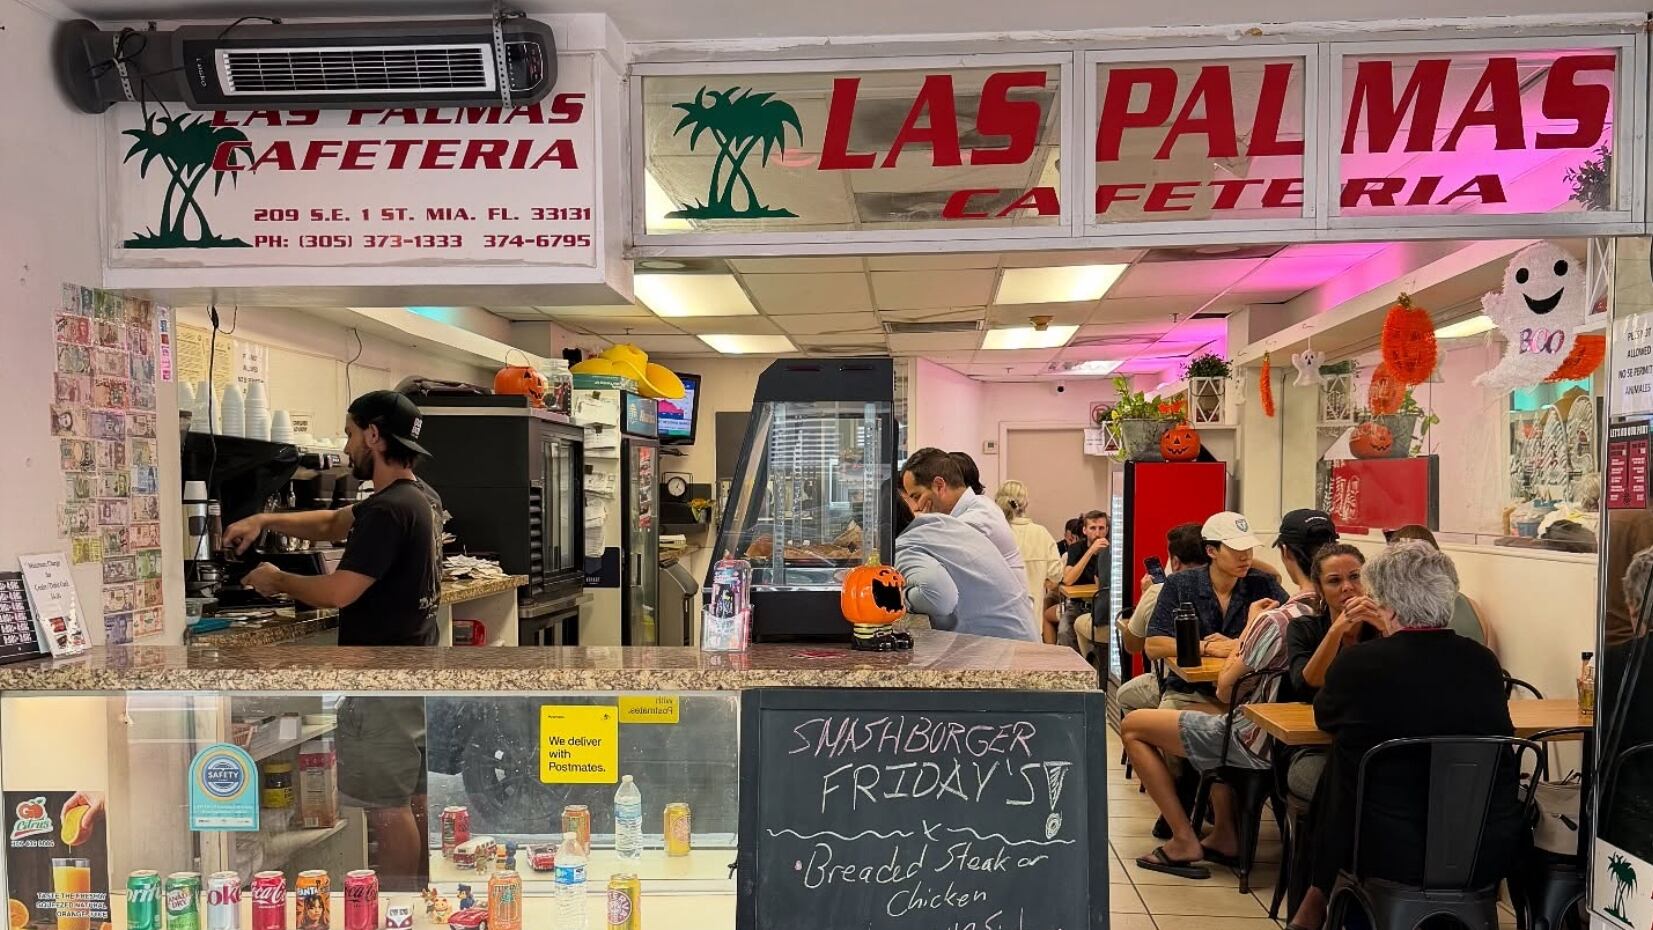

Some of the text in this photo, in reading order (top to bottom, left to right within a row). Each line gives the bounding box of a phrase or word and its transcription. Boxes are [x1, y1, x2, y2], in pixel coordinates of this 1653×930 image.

[817, 55, 1616, 170] LAS PALMAS
[212, 139, 579, 171] CAFETERIA
[941, 174, 1508, 219] CAFETERIA
[254, 207, 591, 222] 209 S.E. 1 ST. MIA. FL. 33131
[254, 234, 591, 248] PH: (305) 373-1333 374-6795
[1518, 327, 1566, 355] BOO
[1626, 345, 1652, 358] ALLOWED
[548, 736, 602, 747] We deliver
[548, 749, 571, 759] with
[548, 761, 606, 773] Postmates.
[207, 771, 239, 779] SAFETY
[934, 840, 1011, 873] Steak
[886, 882, 988, 918] Chicken
